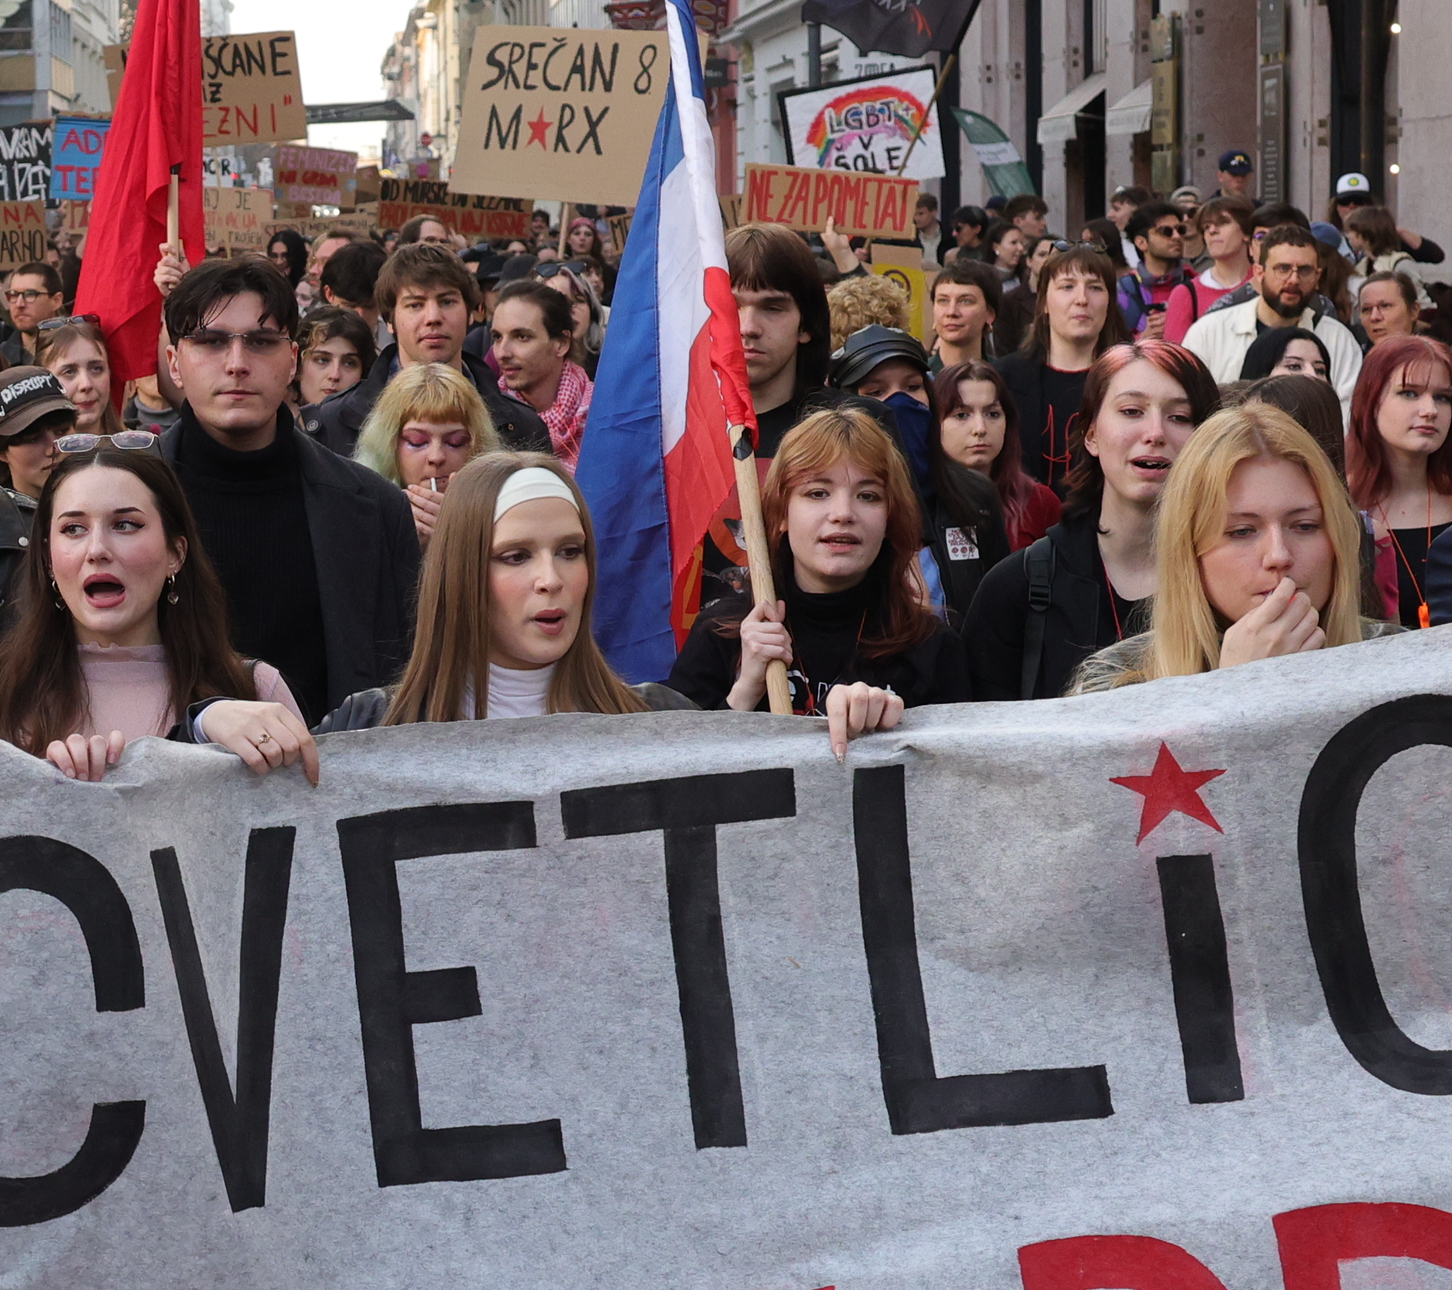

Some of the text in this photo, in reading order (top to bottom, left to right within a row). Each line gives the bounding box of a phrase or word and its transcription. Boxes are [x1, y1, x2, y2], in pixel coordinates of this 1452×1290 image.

[201, 36, 292, 80] ŠČANE
[481, 37, 619, 92] SREČAN
[827, 98, 914, 135] LGBT+
[858, 134, 874, 150] V
[747, 169, 779, 223] NE
[776, 171, 920, 232] ZAPOMETAT
[0, 373, 54, 405] DISRUPT
